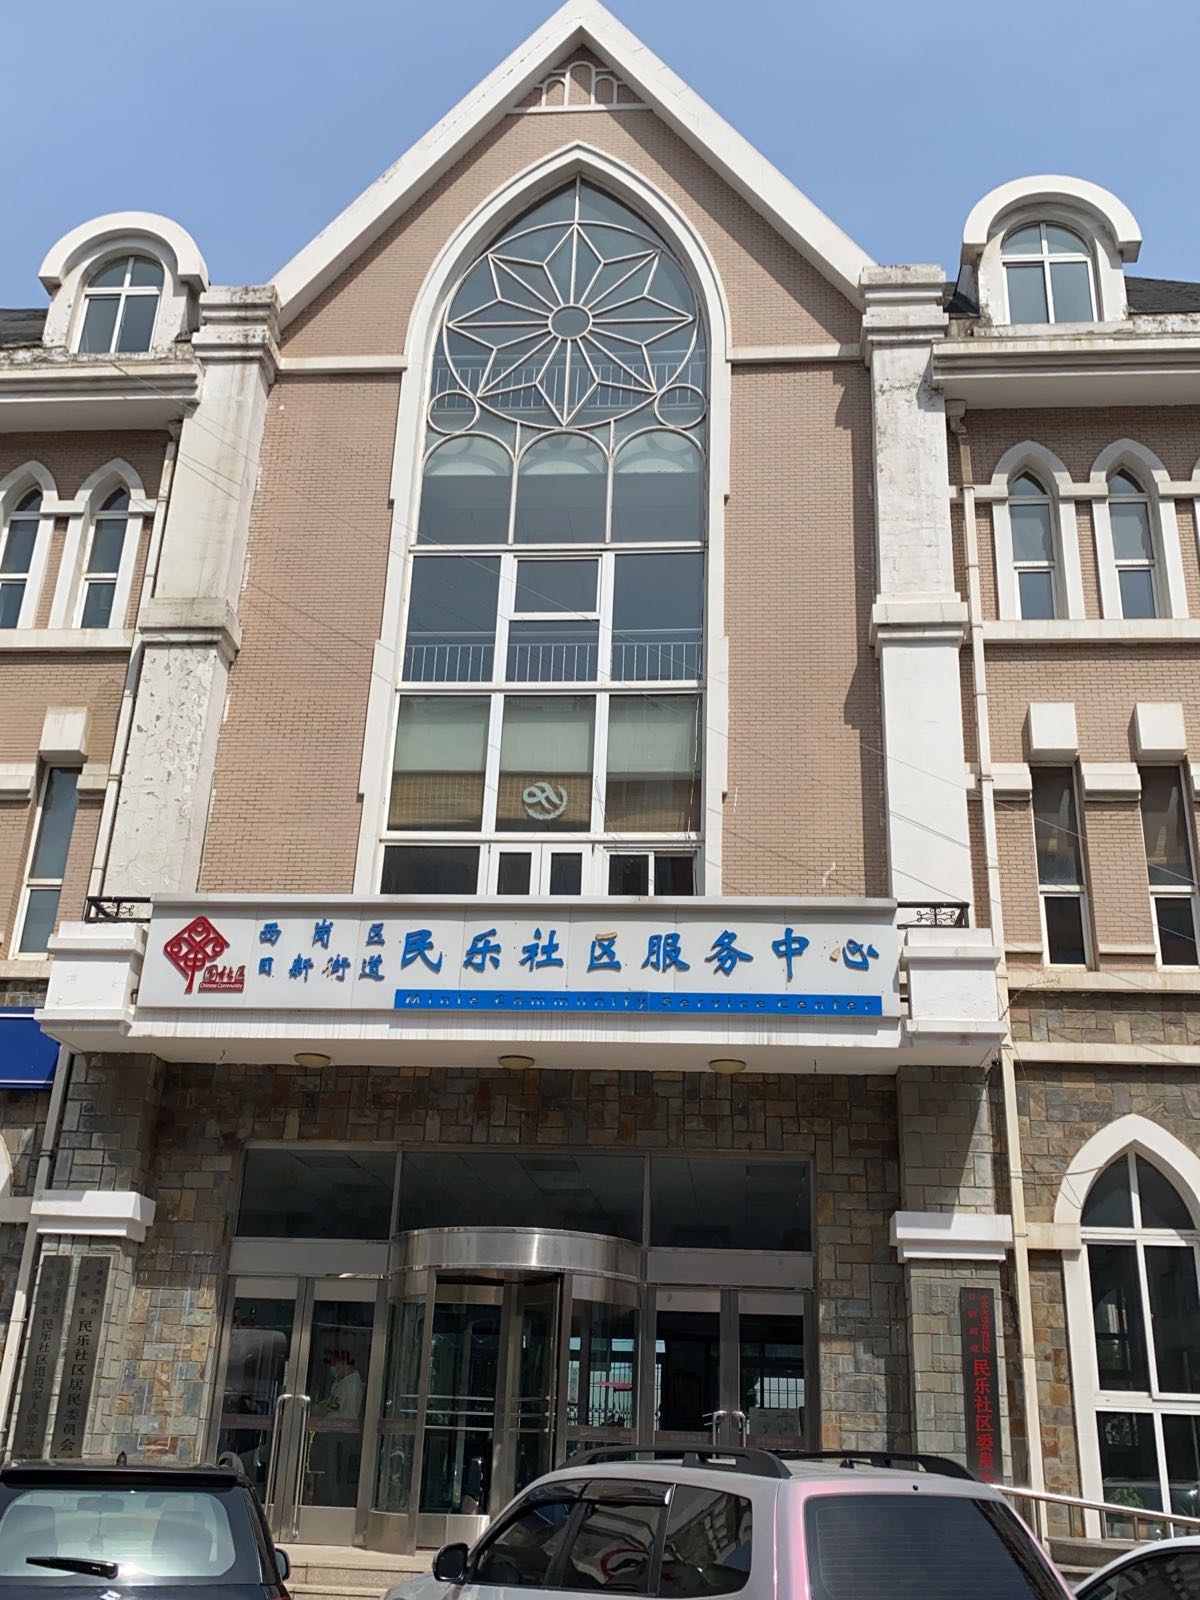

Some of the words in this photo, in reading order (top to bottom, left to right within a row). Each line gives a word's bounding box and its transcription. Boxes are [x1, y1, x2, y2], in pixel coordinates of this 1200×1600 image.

[258, 919, 386, 949] 西岗区
[257, 953, 386, 983] 日新街道
[400, 927, 880, 981] 民乐社区服务中心
[495, 994, 647, 1009] Community
[661, 996, 766, 1008] Service
[777, 998, 872, 1010] Center
[60, 1320, 93, 1451] 民乐社区居民委员会
